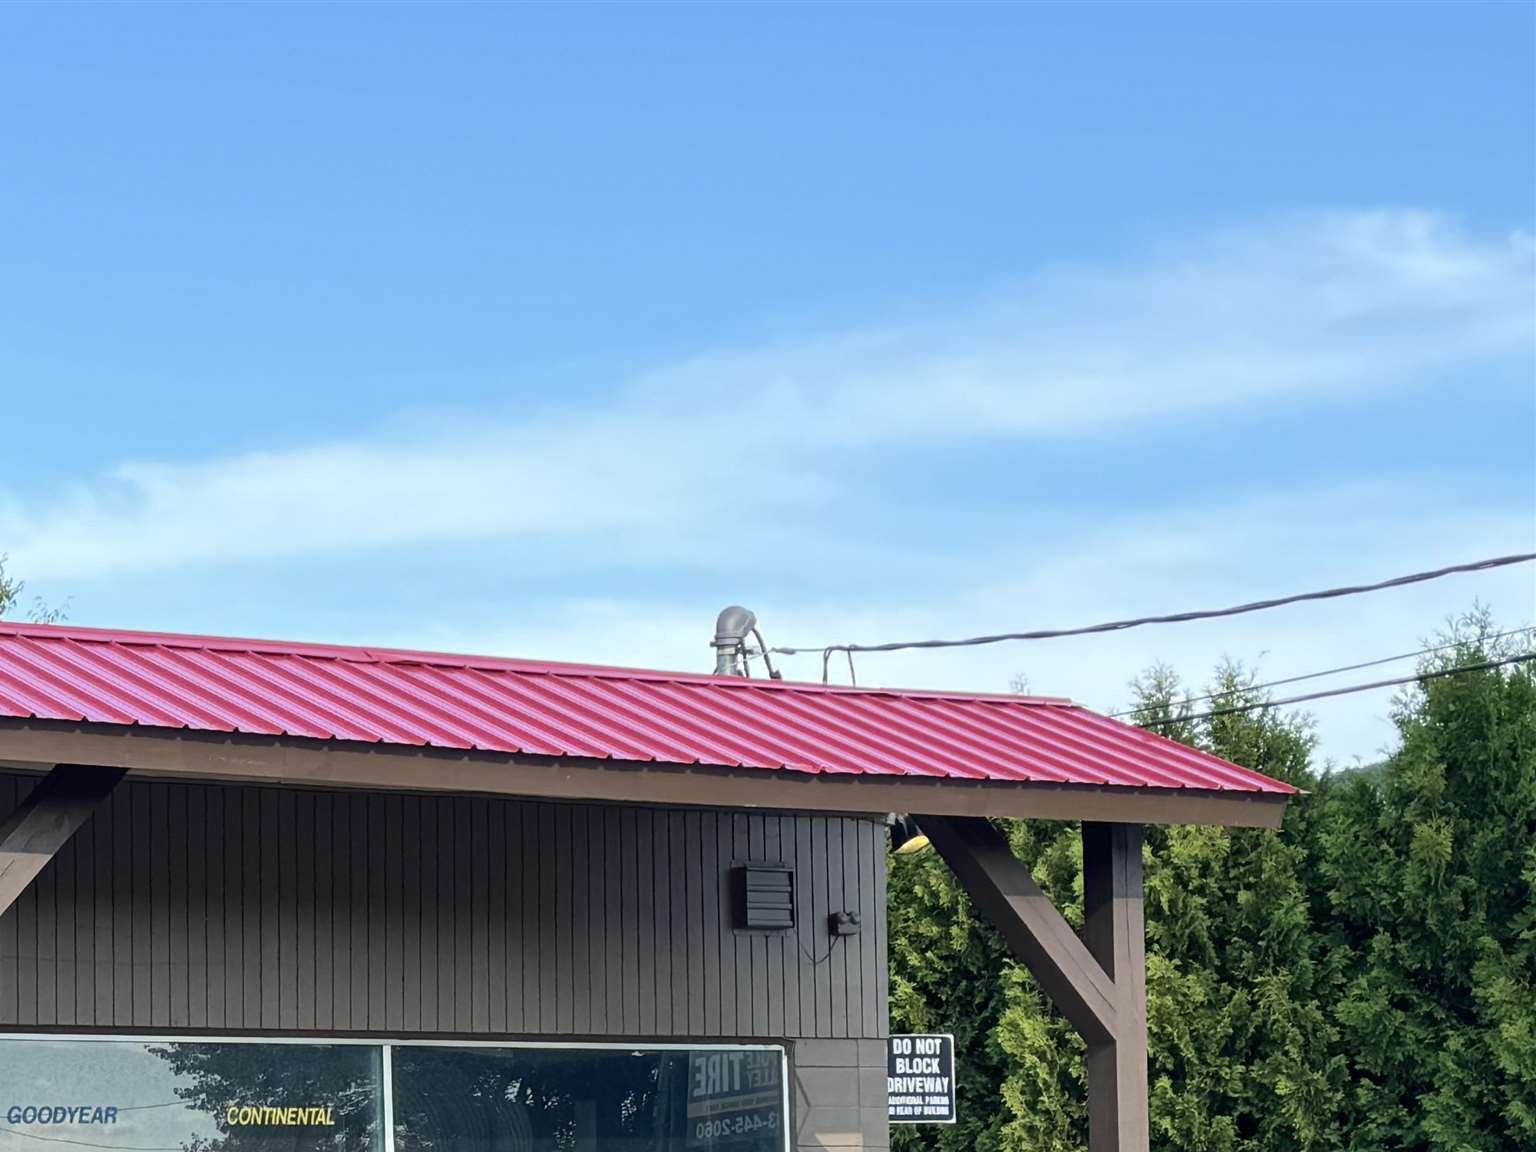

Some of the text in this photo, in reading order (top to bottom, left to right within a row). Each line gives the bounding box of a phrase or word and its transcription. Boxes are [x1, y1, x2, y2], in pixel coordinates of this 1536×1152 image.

[893, 1038, 942, 1055] DO NOT
[895, 1057, 940, 1074] BLOCK
[887, 1076, 949, 1093] DRIVEWAY
[7, 1105, 118, 1125] GOODYEAR
[227, 1106, 335, 1126] CONTINENTAL
